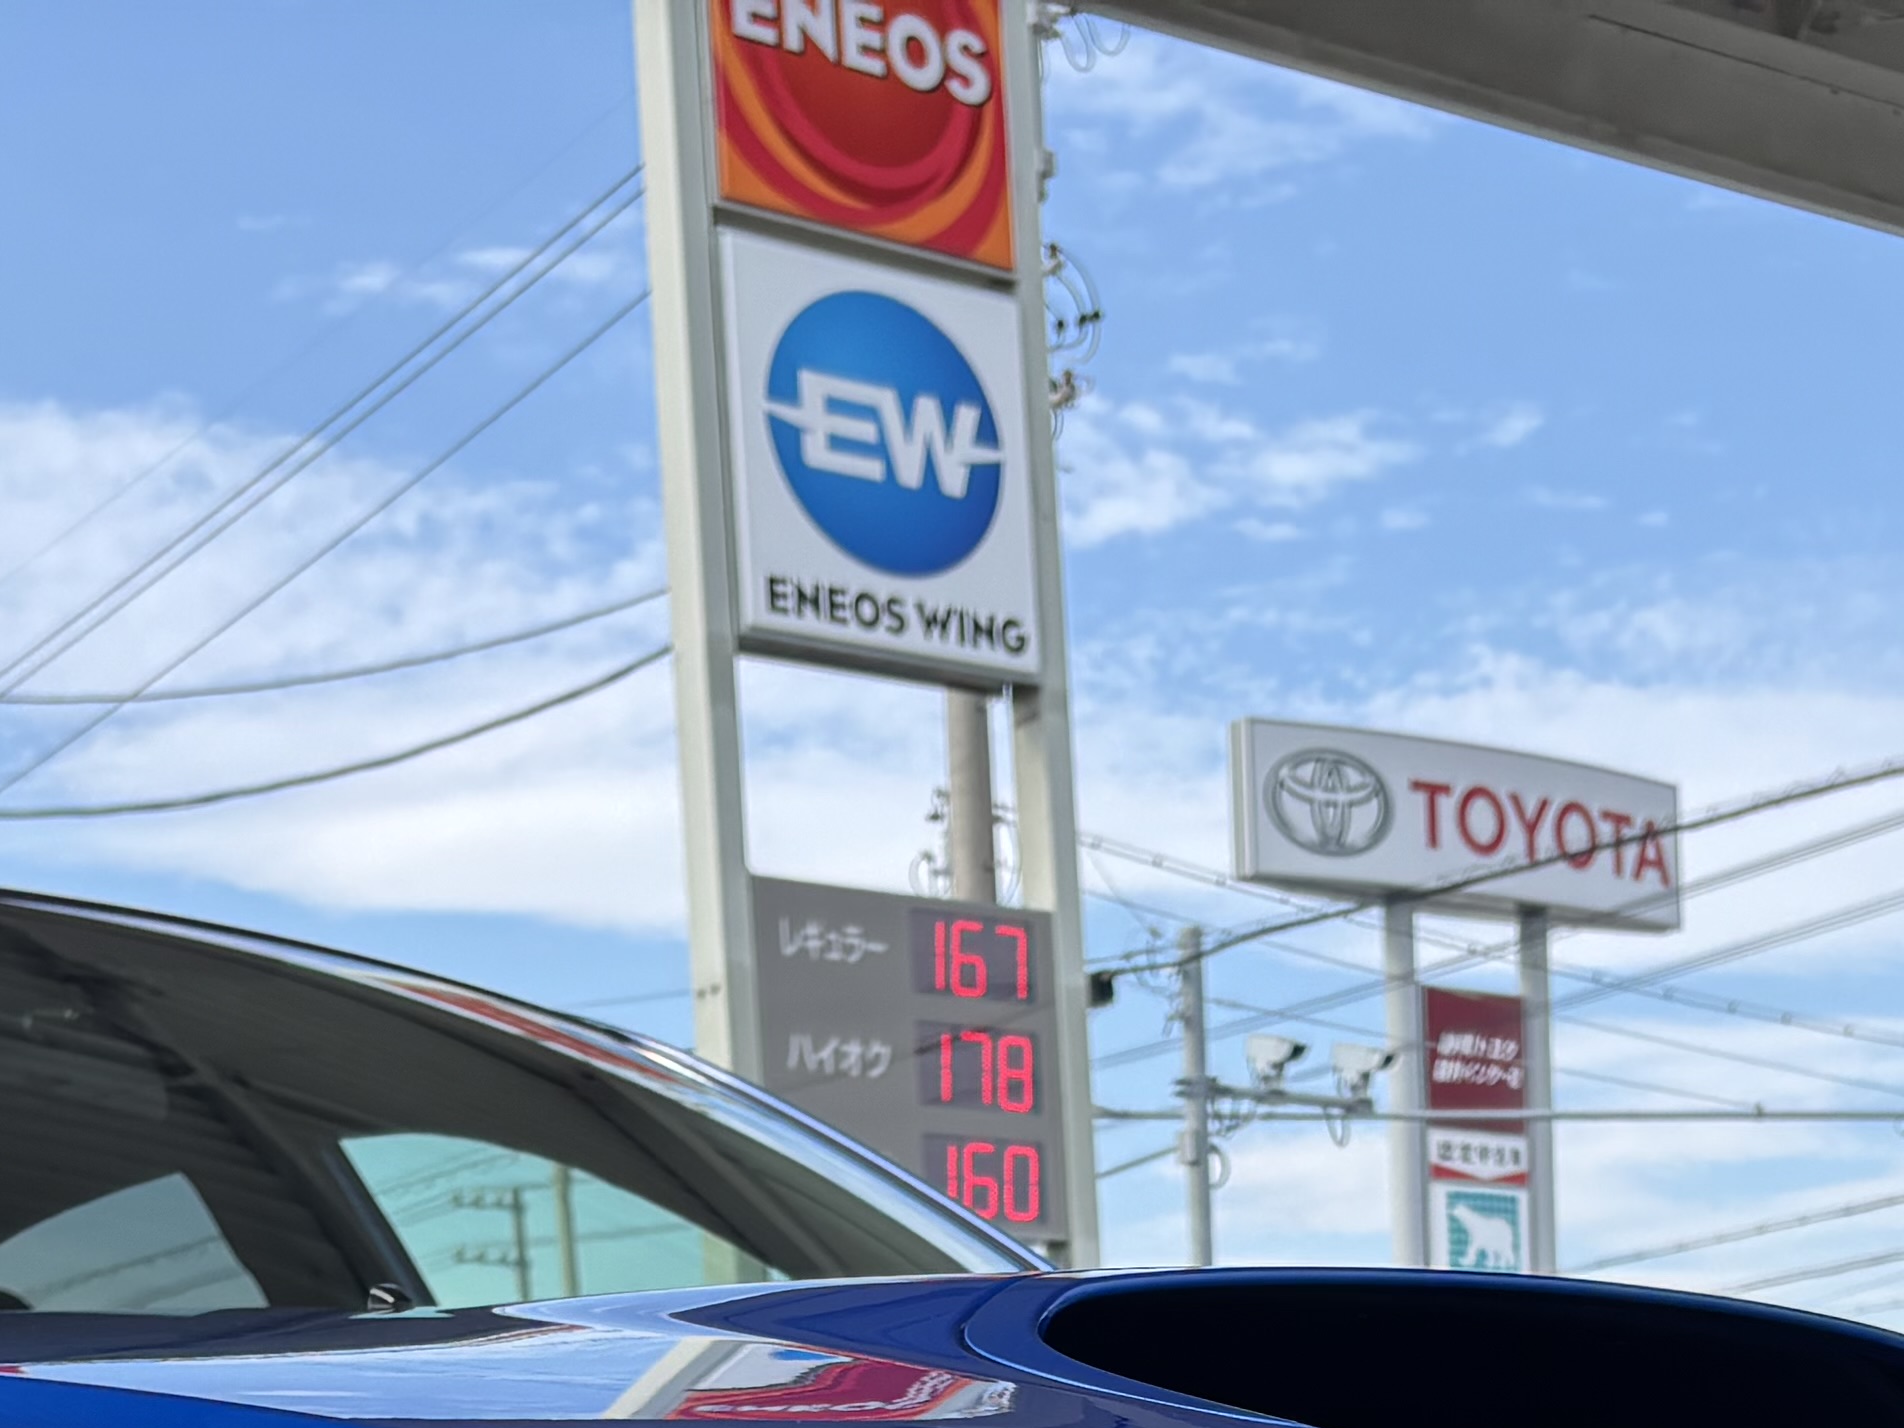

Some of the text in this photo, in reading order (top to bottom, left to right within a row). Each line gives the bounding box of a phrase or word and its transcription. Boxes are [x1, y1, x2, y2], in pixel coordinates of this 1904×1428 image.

[731, 0, 992, 106] ENEOS
[766, 574, 1027, 656] ENEOS WING
[1409, 778, 1671, 888] TOYOTA
[934, 919, 1028, 999] 167
[787, 1033, 892, 1079] ハイオク
[940, 1030, 1034, 1113] 178
[947, 1142, 1039, 1222] 160
